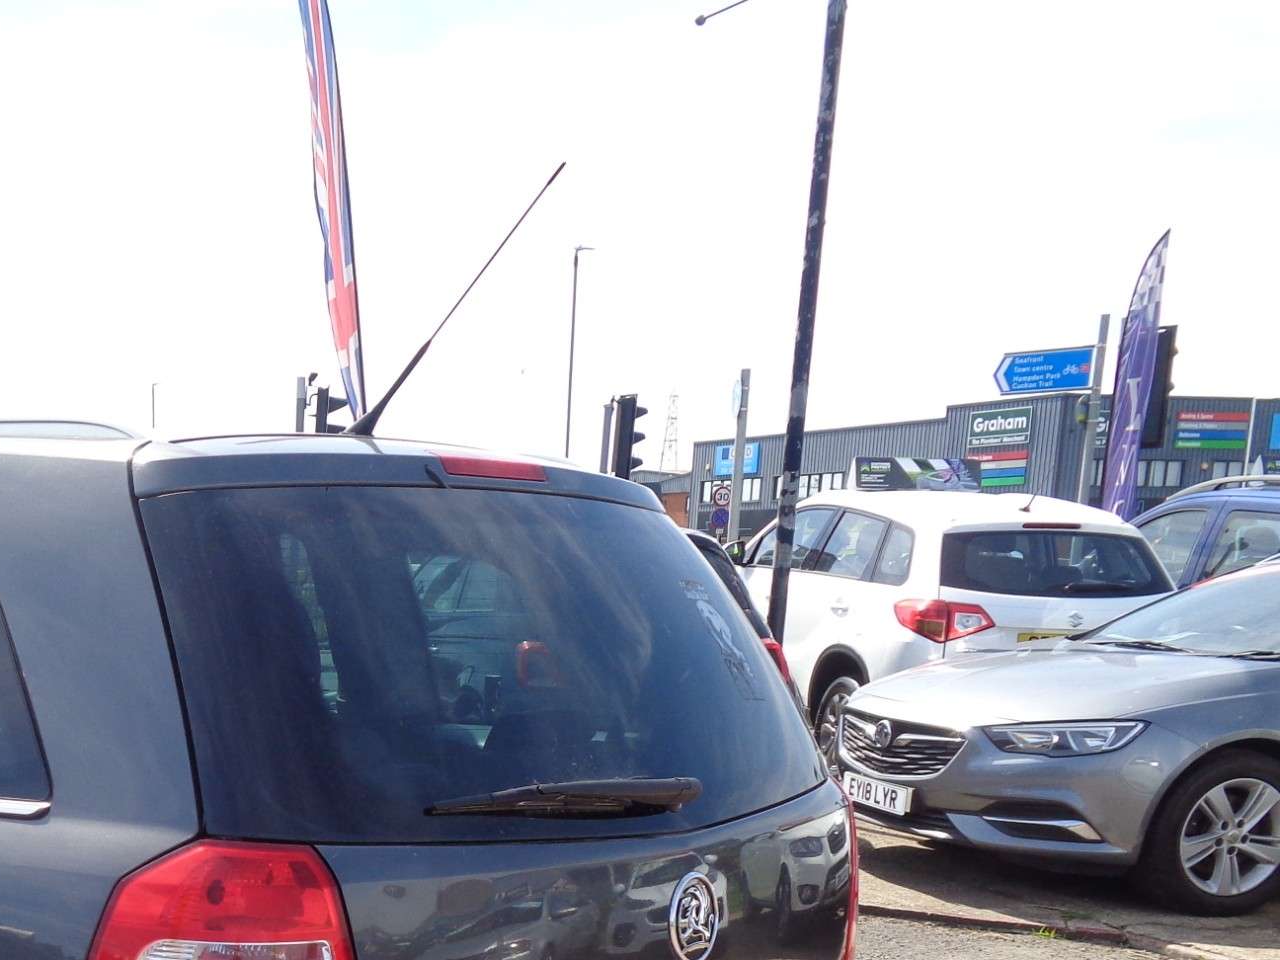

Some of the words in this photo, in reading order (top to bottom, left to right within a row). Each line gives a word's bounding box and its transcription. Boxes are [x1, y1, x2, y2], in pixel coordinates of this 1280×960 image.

[973, 415, 1027, 433] Graham
[848, 777, 873, 801] EY18
[873, 784, 898, 810] LYR
